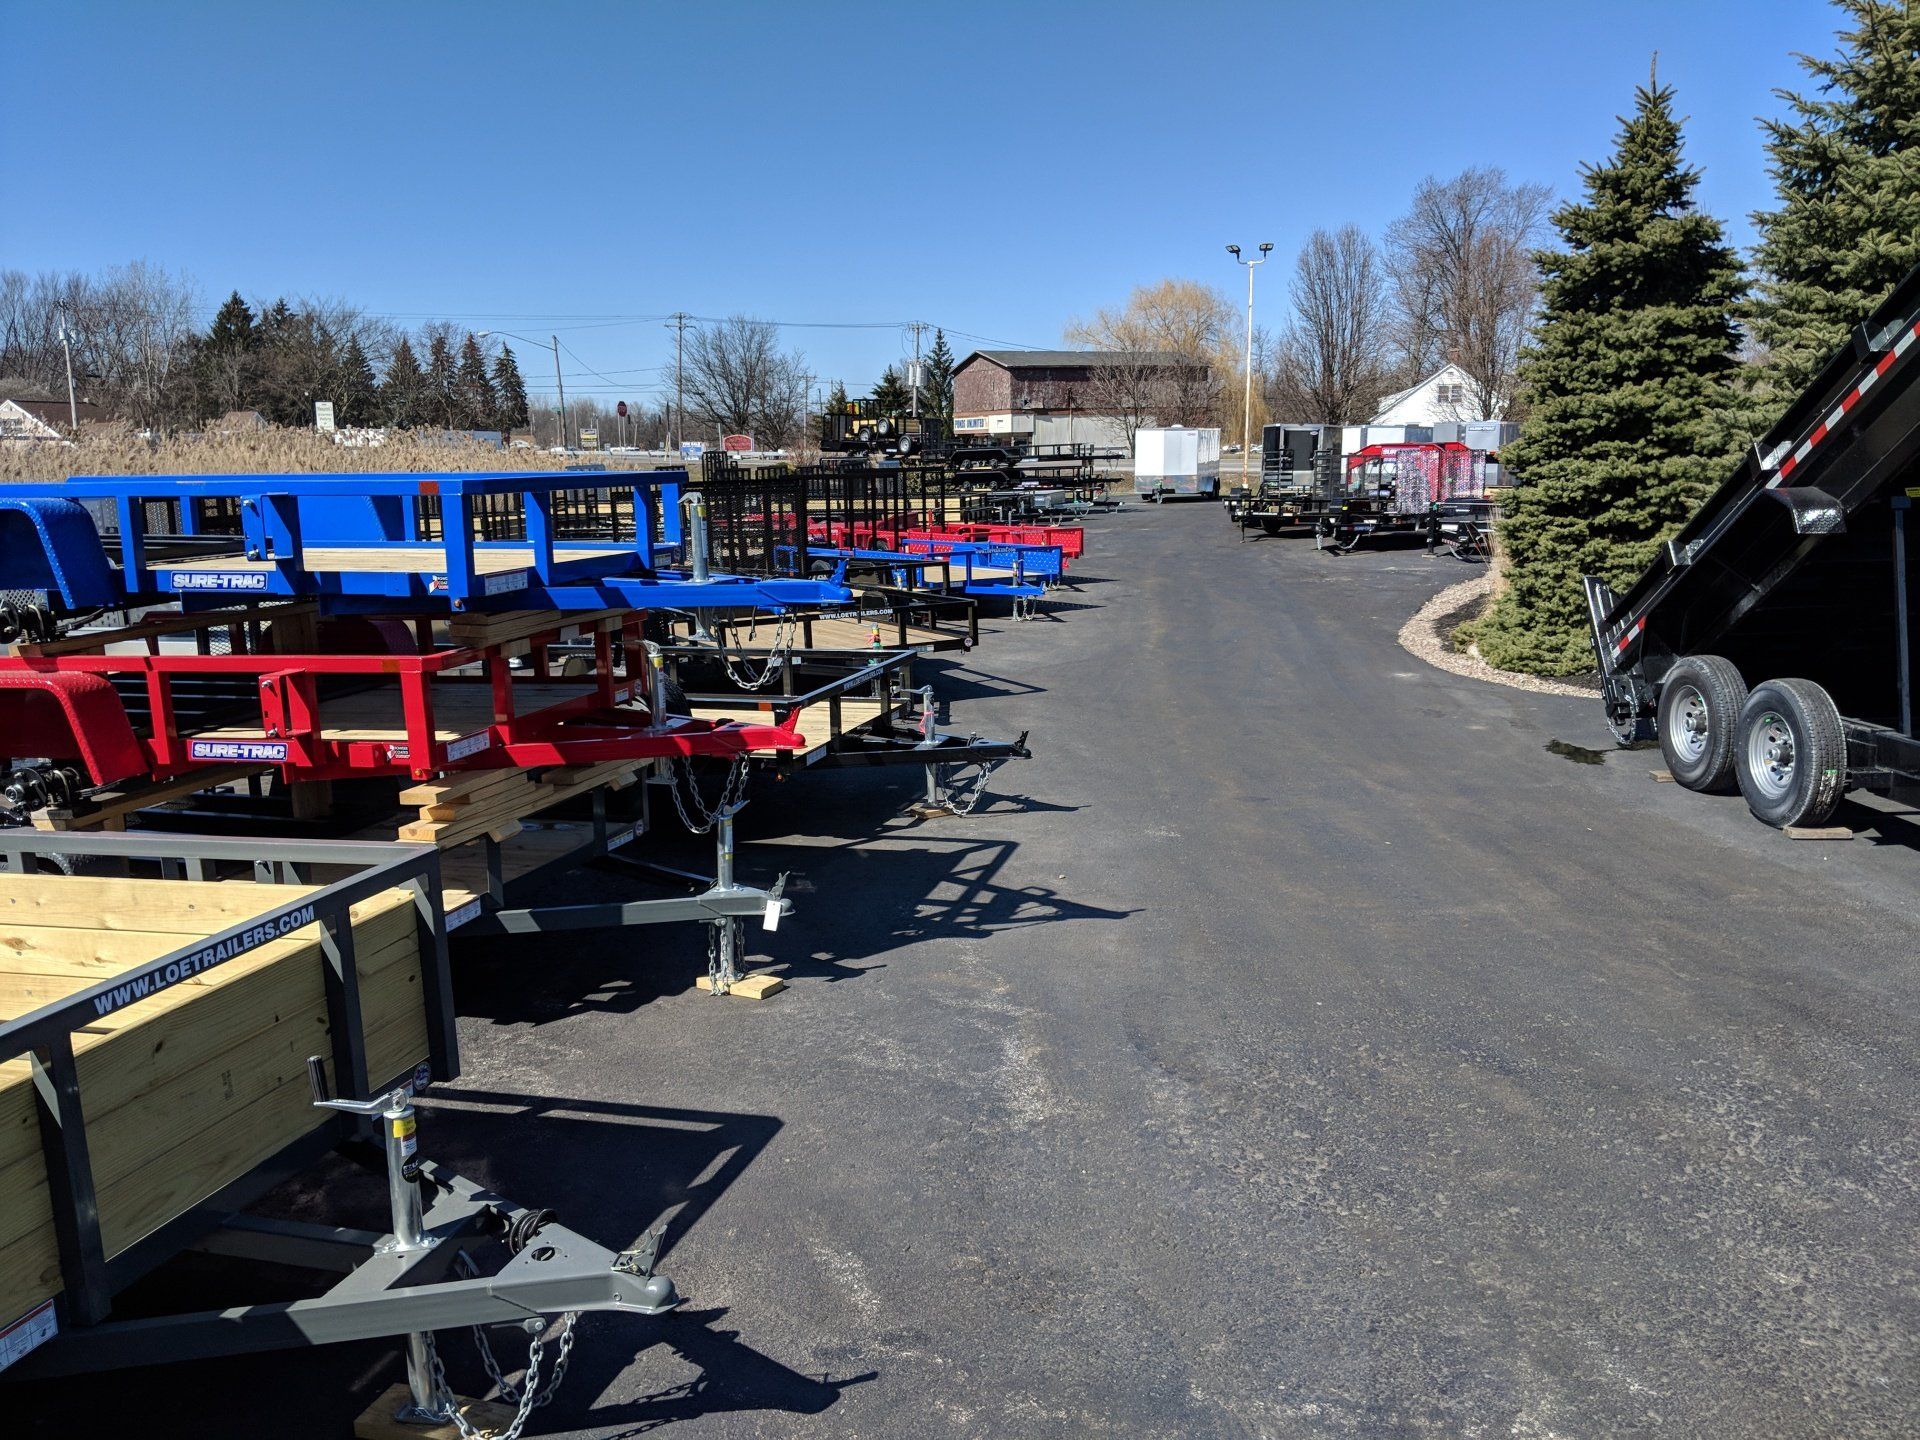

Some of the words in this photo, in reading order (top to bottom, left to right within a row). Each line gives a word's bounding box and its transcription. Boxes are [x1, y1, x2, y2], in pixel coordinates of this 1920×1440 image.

[173, 573, 266, 589] SURE-TRAC
[819, 608, 894, 620] WWW.LOETRILERS.COM
[194, 743, 286, 760] SURE-TRAC
[94, 904, 316, 1016] WWW.LOETRAILERS.COM
